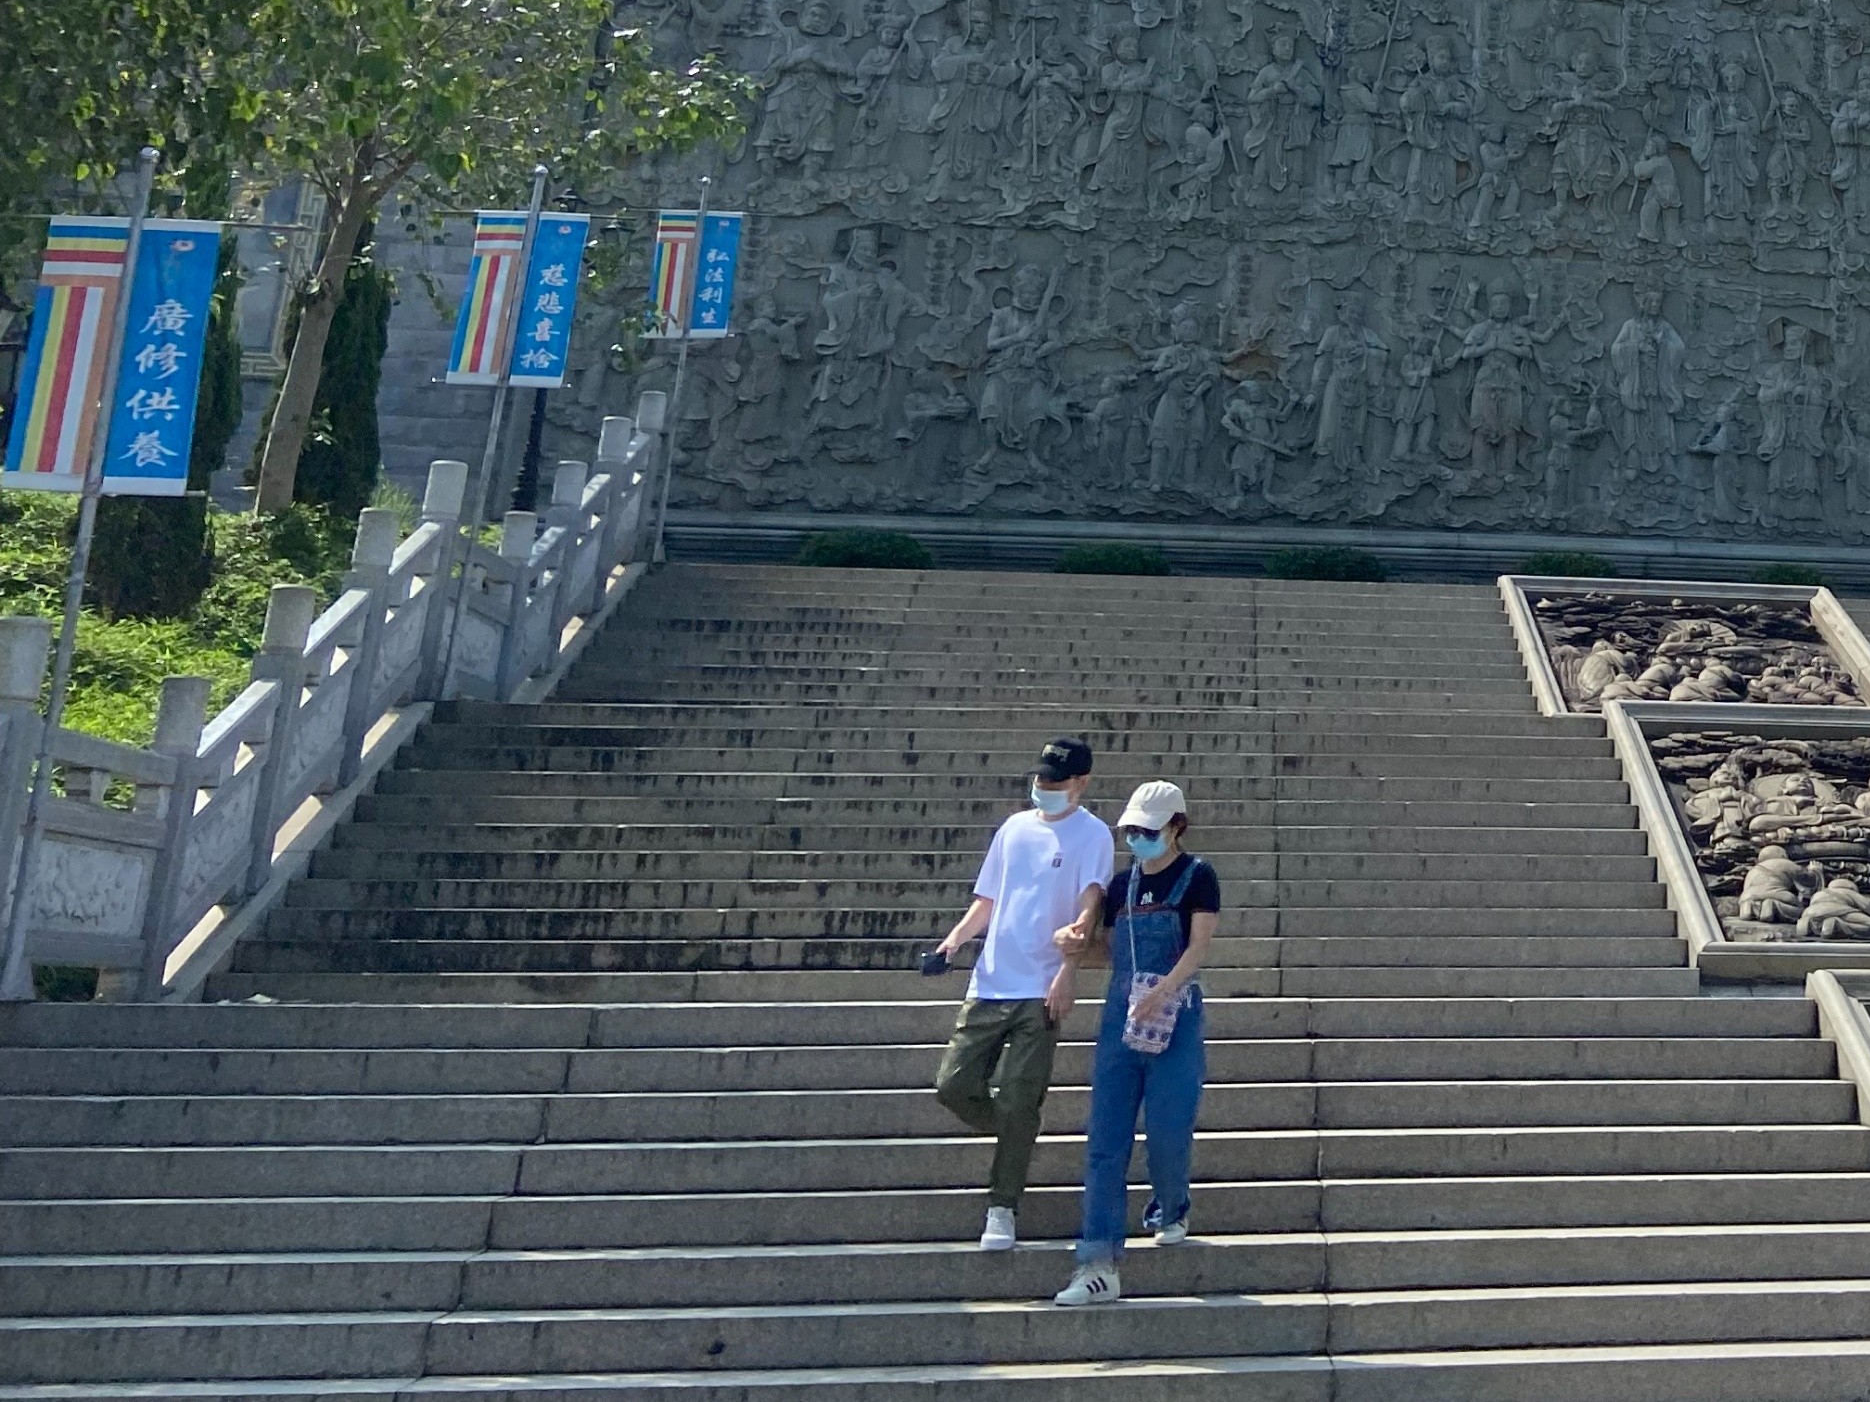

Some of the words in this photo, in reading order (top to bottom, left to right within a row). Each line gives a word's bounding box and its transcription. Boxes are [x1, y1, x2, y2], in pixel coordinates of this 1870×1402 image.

[519, 263, 568, 369] 慈悲喜捨
[698, 248, 729, 324] 弘法利生
[118, 298, 193, 467] 廣修供養
